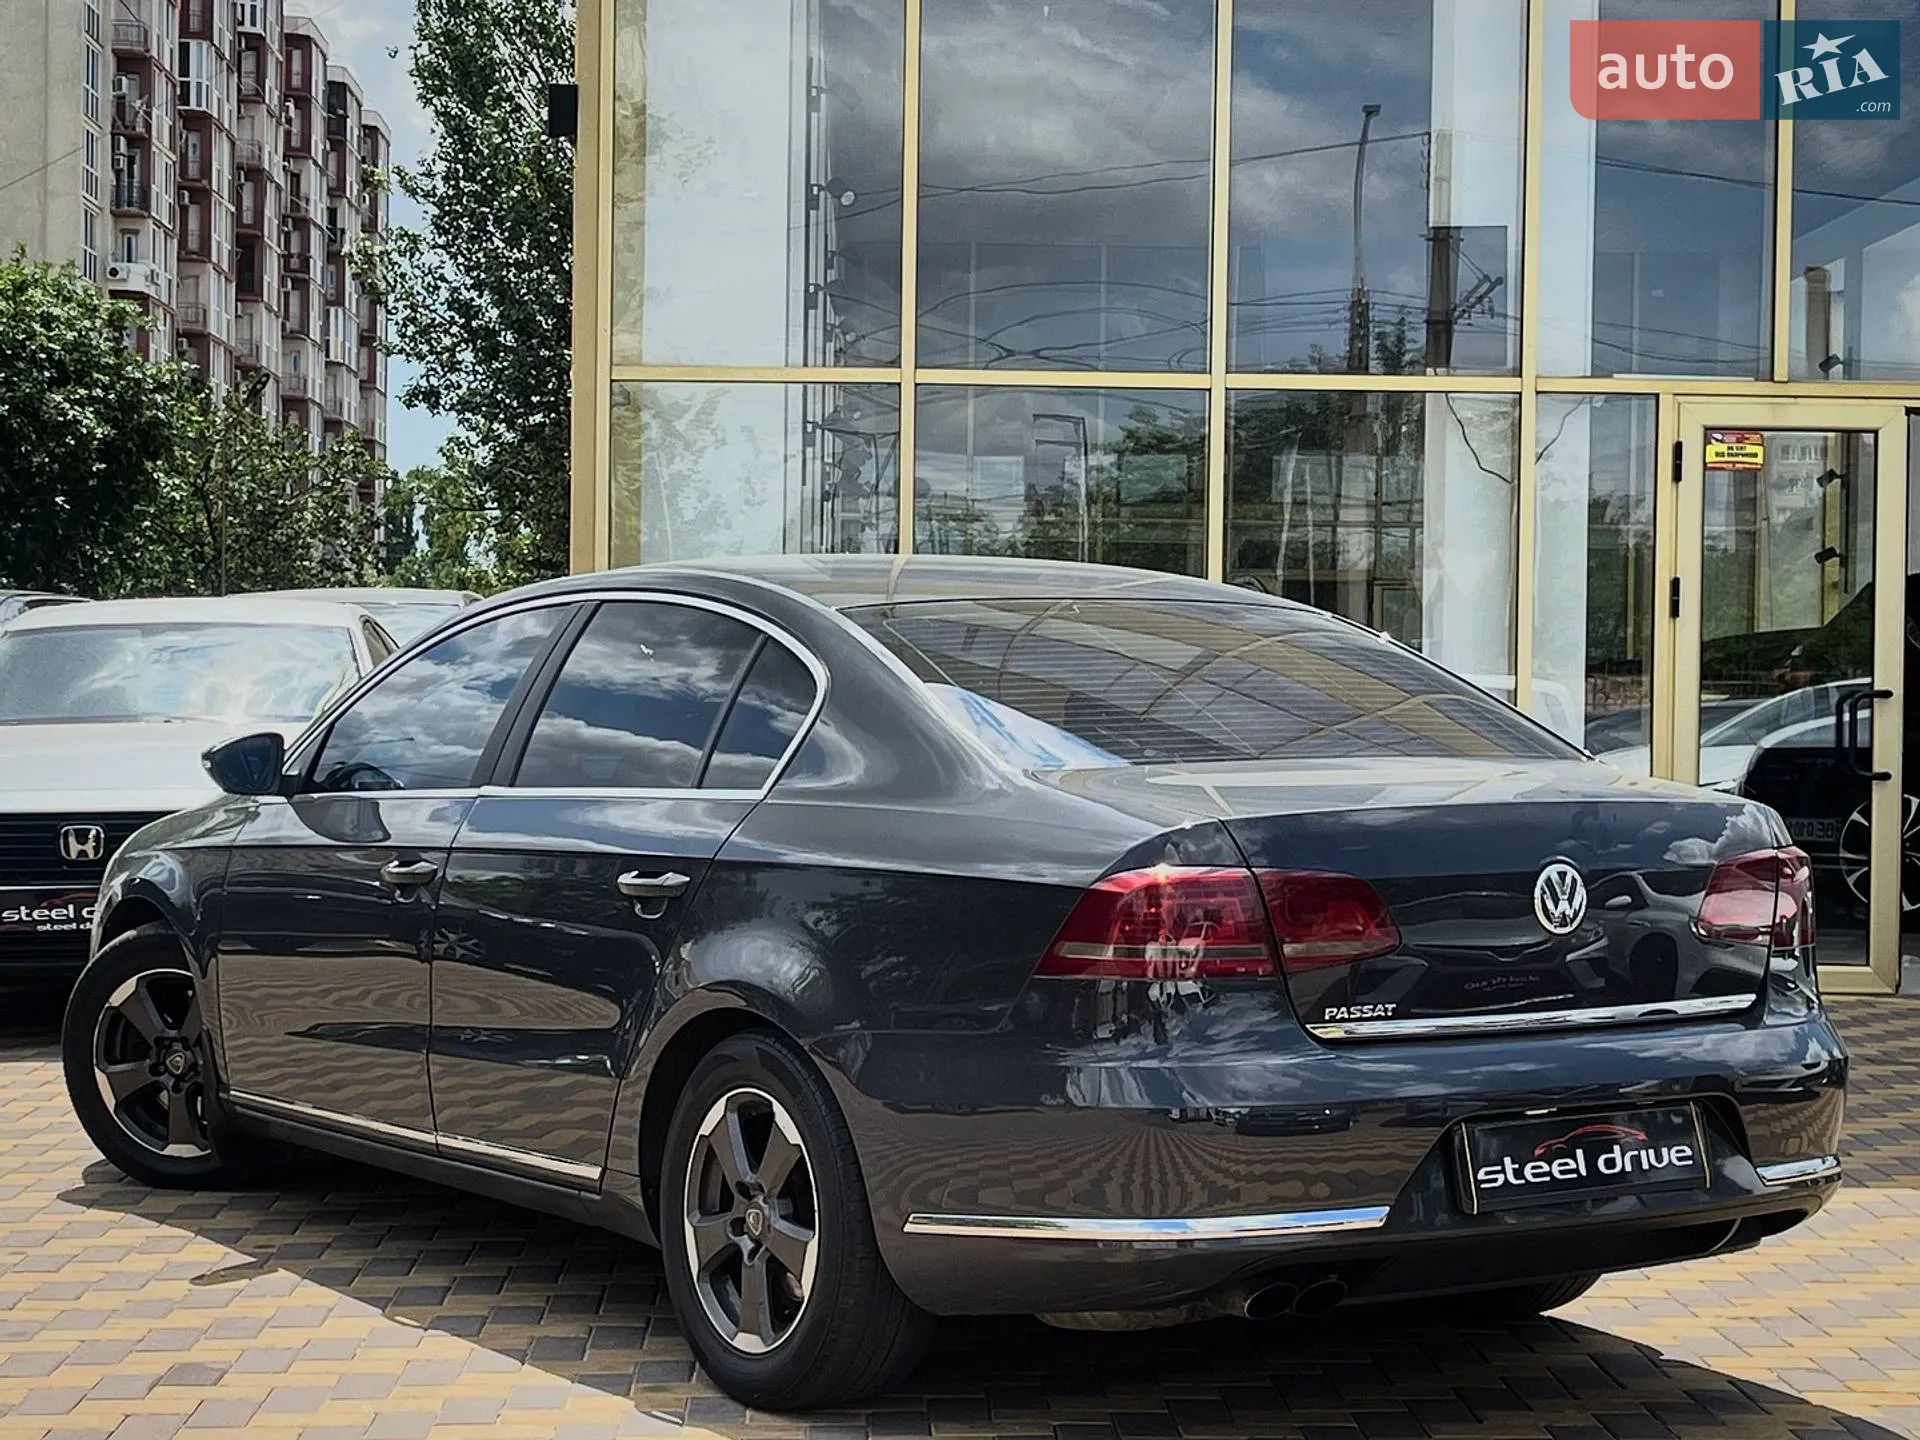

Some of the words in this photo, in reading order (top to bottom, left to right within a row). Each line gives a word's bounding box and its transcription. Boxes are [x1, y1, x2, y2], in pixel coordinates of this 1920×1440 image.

[1, 904, 75, 922] steel
[36, 922, 77, 932] steel
[1324, 1003, 1397, 1020] PASSAT
[1477, 1148, 1587, 1189] steel
[1597, 1144, 1693, 1175] drive
